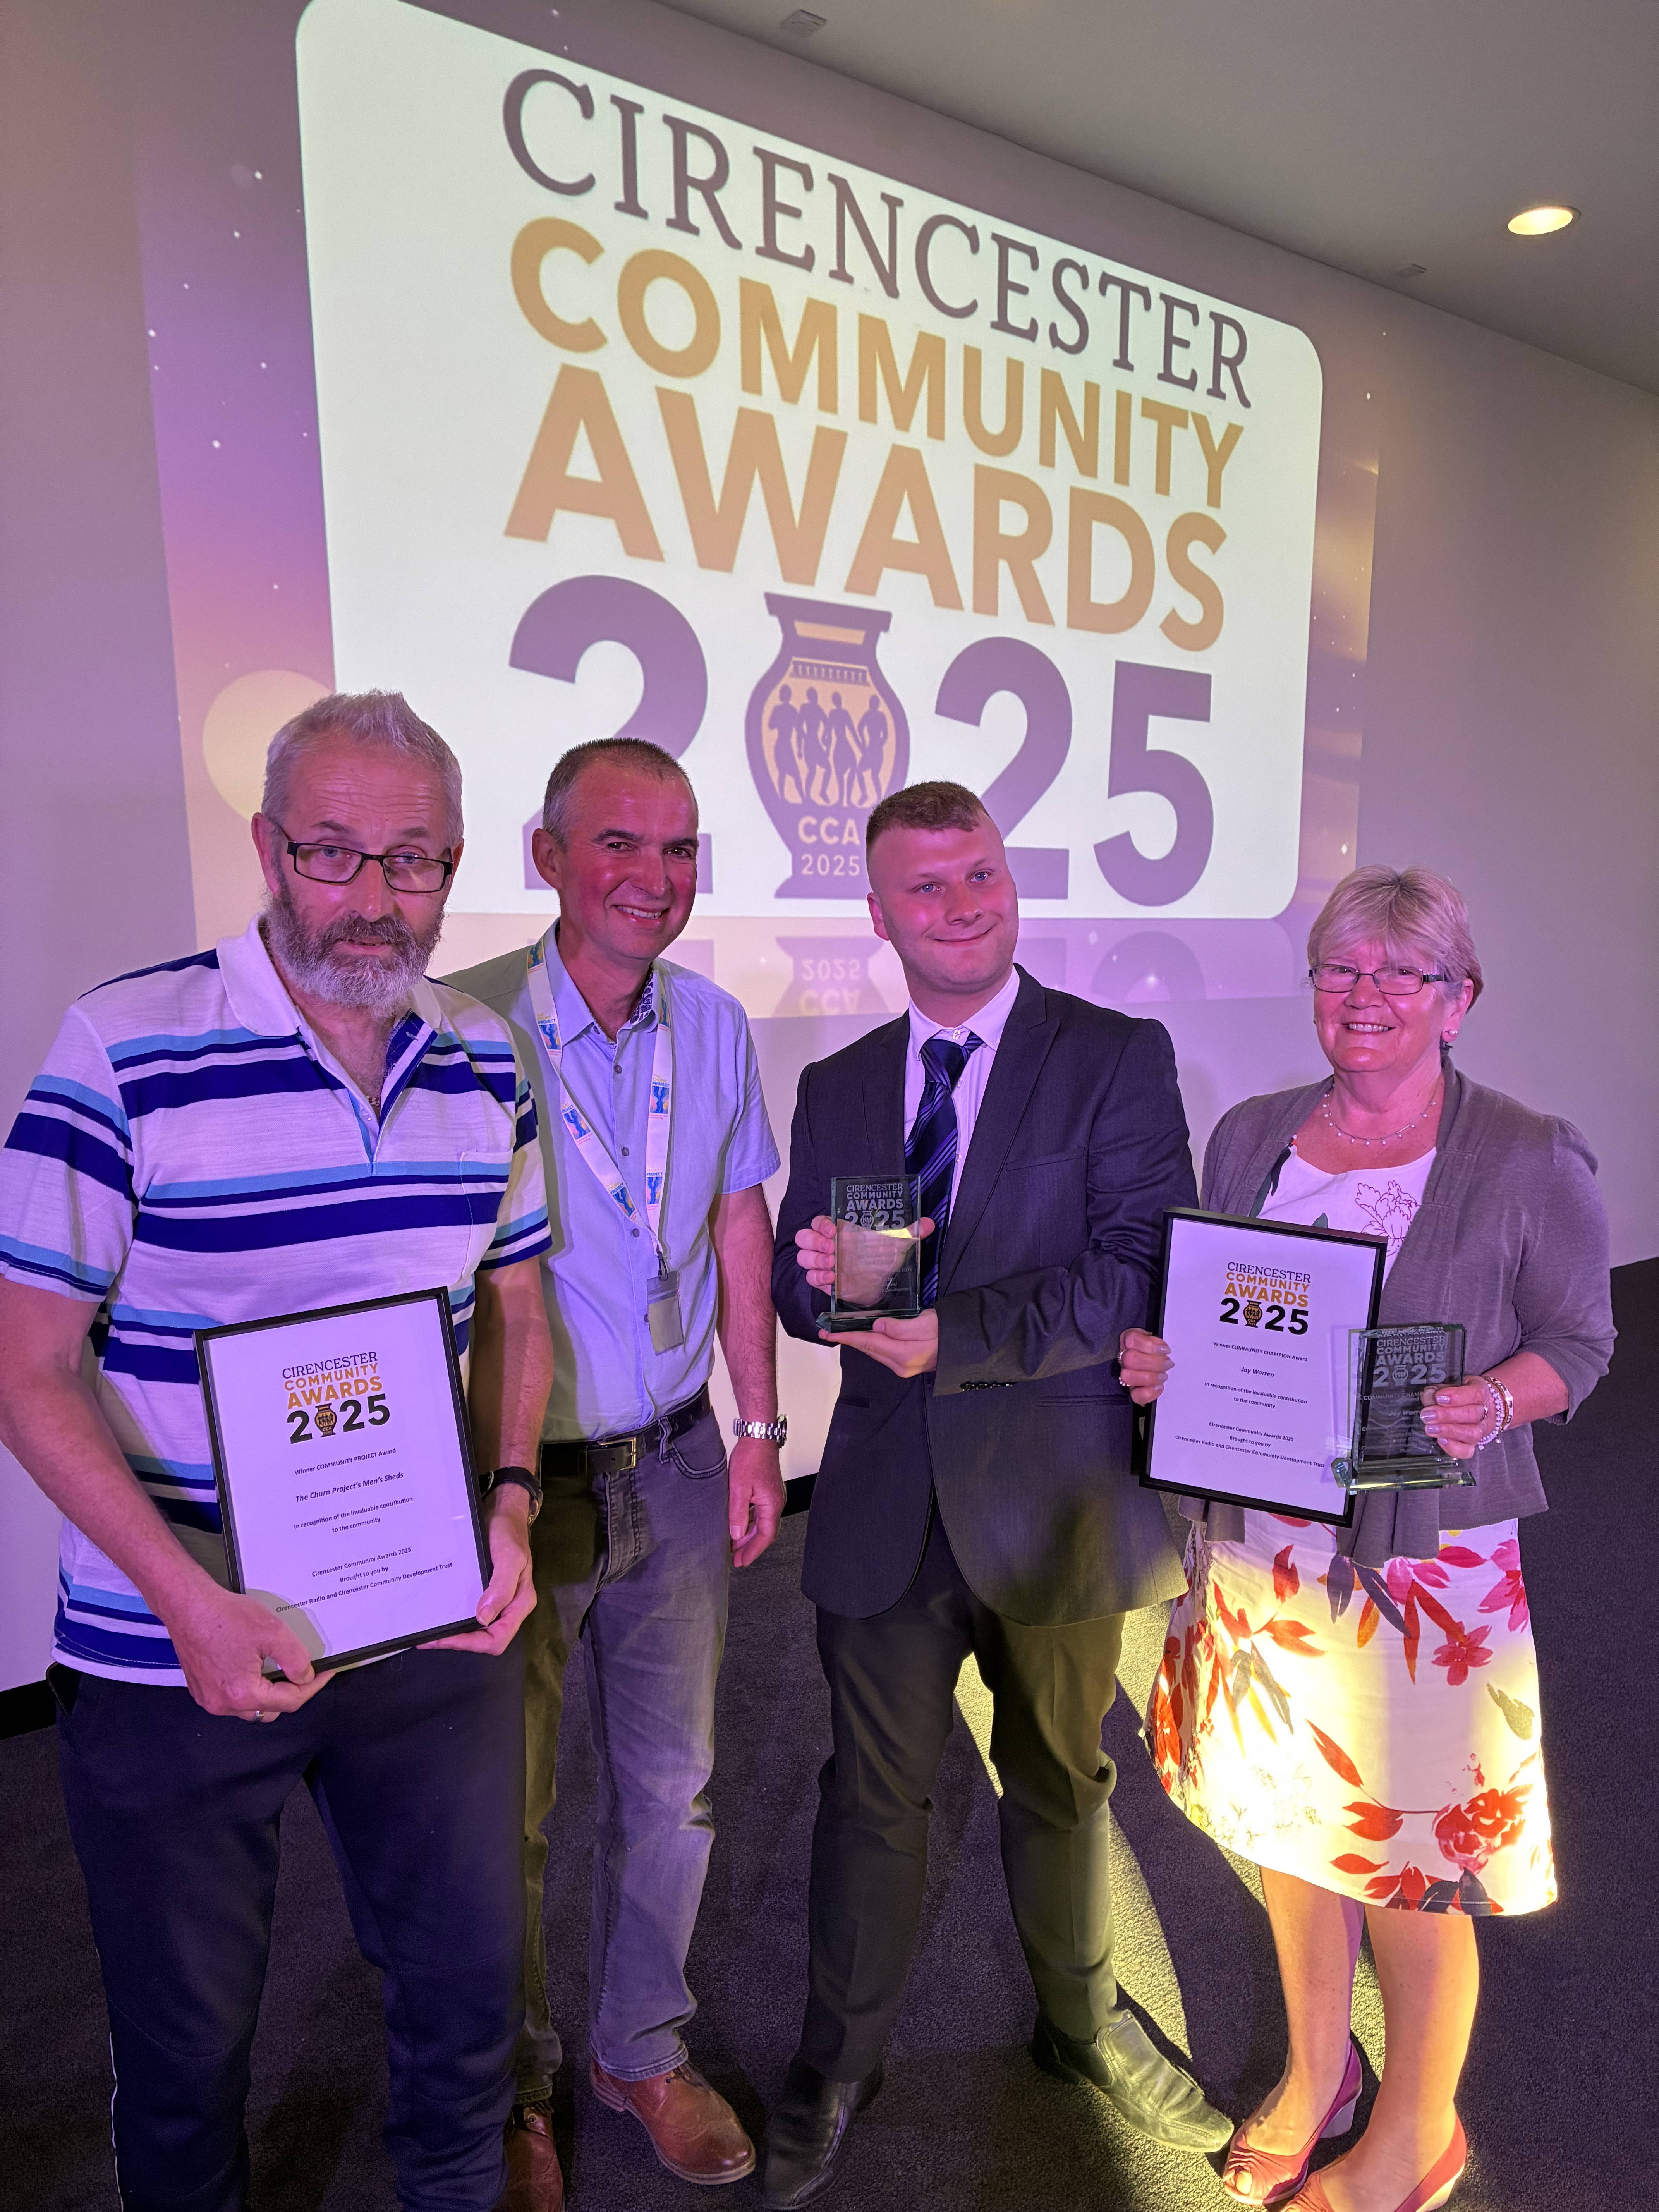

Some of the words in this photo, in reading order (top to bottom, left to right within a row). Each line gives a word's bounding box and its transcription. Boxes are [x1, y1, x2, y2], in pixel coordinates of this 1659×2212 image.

[502, 68, 1251, 408] CIRENCESTER
[510, 217, 1243, 508] COMMUNITY
[504, 364, 1227, 651] AWARDS
[798, 816, 860, 846] CCA
[801, 854, 860, 876] 2025
[846, 1183, 903, 1192] CIRENCESTER
[847, 1190, 903, 1199] COMMUNITY
[846, 1198, 903, 1211] AWARDS
[1226, 1272, 1310, 1292] COMMUNITY
[1227, 1262, 1311, 1283] CIRENCESTER
[1224, 1282, 1309, 1307] AWARDS
[1231, 1345, 1263, 1354] COMMUNITY
[1264, 1350, 1291, 1359] CHAMPION
[1376, 1343, 1445, 1355] COMMUNITY
[1377, 1336, 1445, 1347] CIRENCESTER
[282, 1352, 378, 1379] CIRENCESTER
[1375, 1352, 1445, 1366] AWARDS
[284, 1362, 378, 1391] COMMUNITY
[1252, 1369, 1274, 1377] Warren
[288, 1376, 382, 1410] AWARDS
[1210, 1383, 1237, 1391] recognition
[1252, 1390, 1277, 1399] invaluable
[1277, 1396, 1307, 1404] contribution
[1249, 1400, 1275, 1409] community
[1209, 1422, 1235, 1431] Cirencester
[1235, 1427, 1263, 1437] Community
[1175, 1435, 1201, 1444] Cirencester
[1225, 1445, 1252, 1453] Cirencester
[1252, 1450, 1279, 1460] Community
[1280, 1455, 1312, 1465] Development
[294, 1467, 315, 1475] Winner
[316, 1457, 353, 1470] COMMUNITY
[354, 1452, 377, 1462] PROJECT
[378, 1448, 396, 1456] Award
[295, 1494, 308, 1503] The
[310, 1490, 330, 1499] Churn
[384, 1472, 404, 1482] Sheds
[301, 1516, 333, 1528] recognition
[351, 1505, 379, 1516] invaluable
[380, 1497, 413, 1509] contribution
[350, 1518, 381, 1529] community
[312, 1565, 343, 1577] Cirencester
[344, 1557, 376, 1569] Community
[377, 1551, 397, 1560] Awards
[398, 1547, 412, 1555] 2025
[340, 1573, 362, 1583] Brought
[276, 1600, 308, 1613] Cirencester
[309, 1596, 325, 1604] Radio
[338, 1584, 369, 1596] Cirencester
[370, 1576, 402, 1588] Community
[402, 1566, 438, 1579] Development
